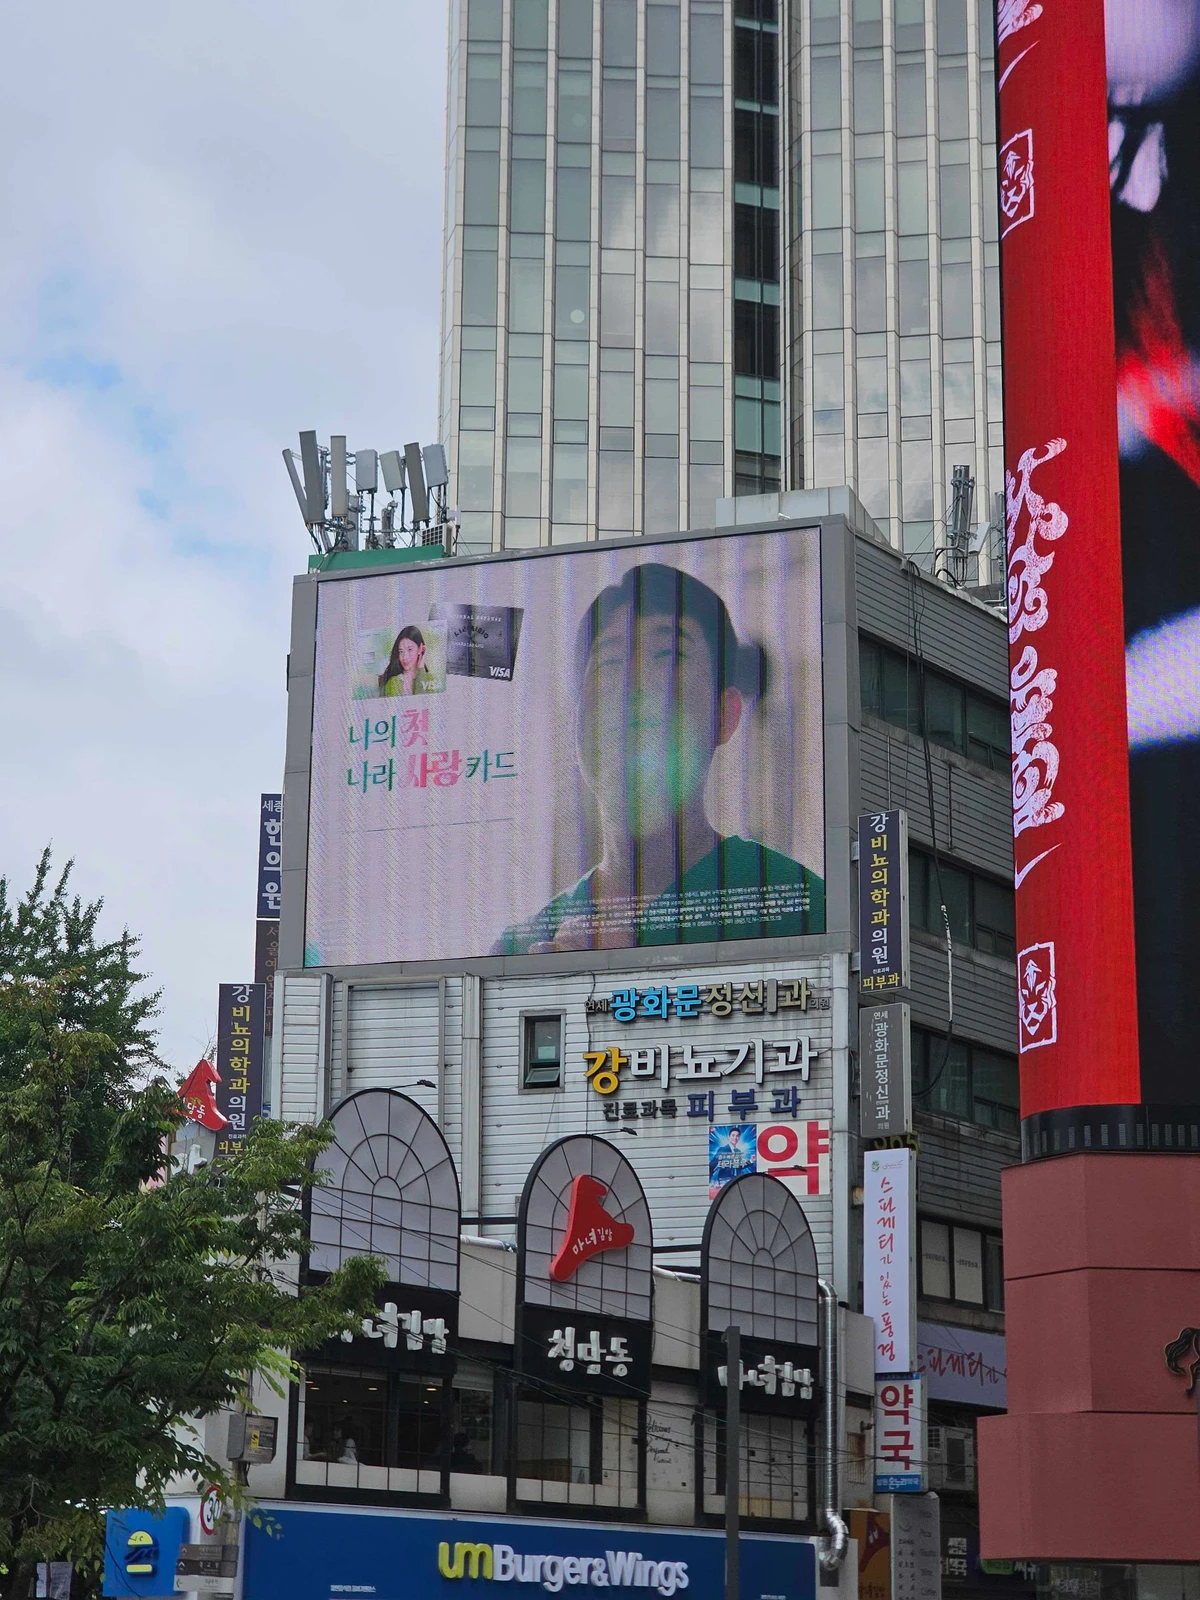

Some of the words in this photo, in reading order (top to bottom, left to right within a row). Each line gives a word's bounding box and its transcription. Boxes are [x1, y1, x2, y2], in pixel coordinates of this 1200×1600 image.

[488, 666, 511, 678] VISA
[348, 715, 397, 751] 나의
[402, 708, 428, 748] 첫
[863, 972, 900, 990] 피부과
[584, 998, 608, 1013] 연세
[809, 998, 830, 1012] 의원
[582, 1035, 819, 1094] 강비뇨기과
[603, 1098, 677, 1122] 진료과목
[686, 1085, 801, 1122] 피부과
[757, 1121, 829, 1195] 약
[329, 1302, 450, 1354] 녀김밥
[547, 1326, 633, 1377] 청담동
[880, 1384, 914, 1471] 약국
[206, 1497, 219, 1523] 30
